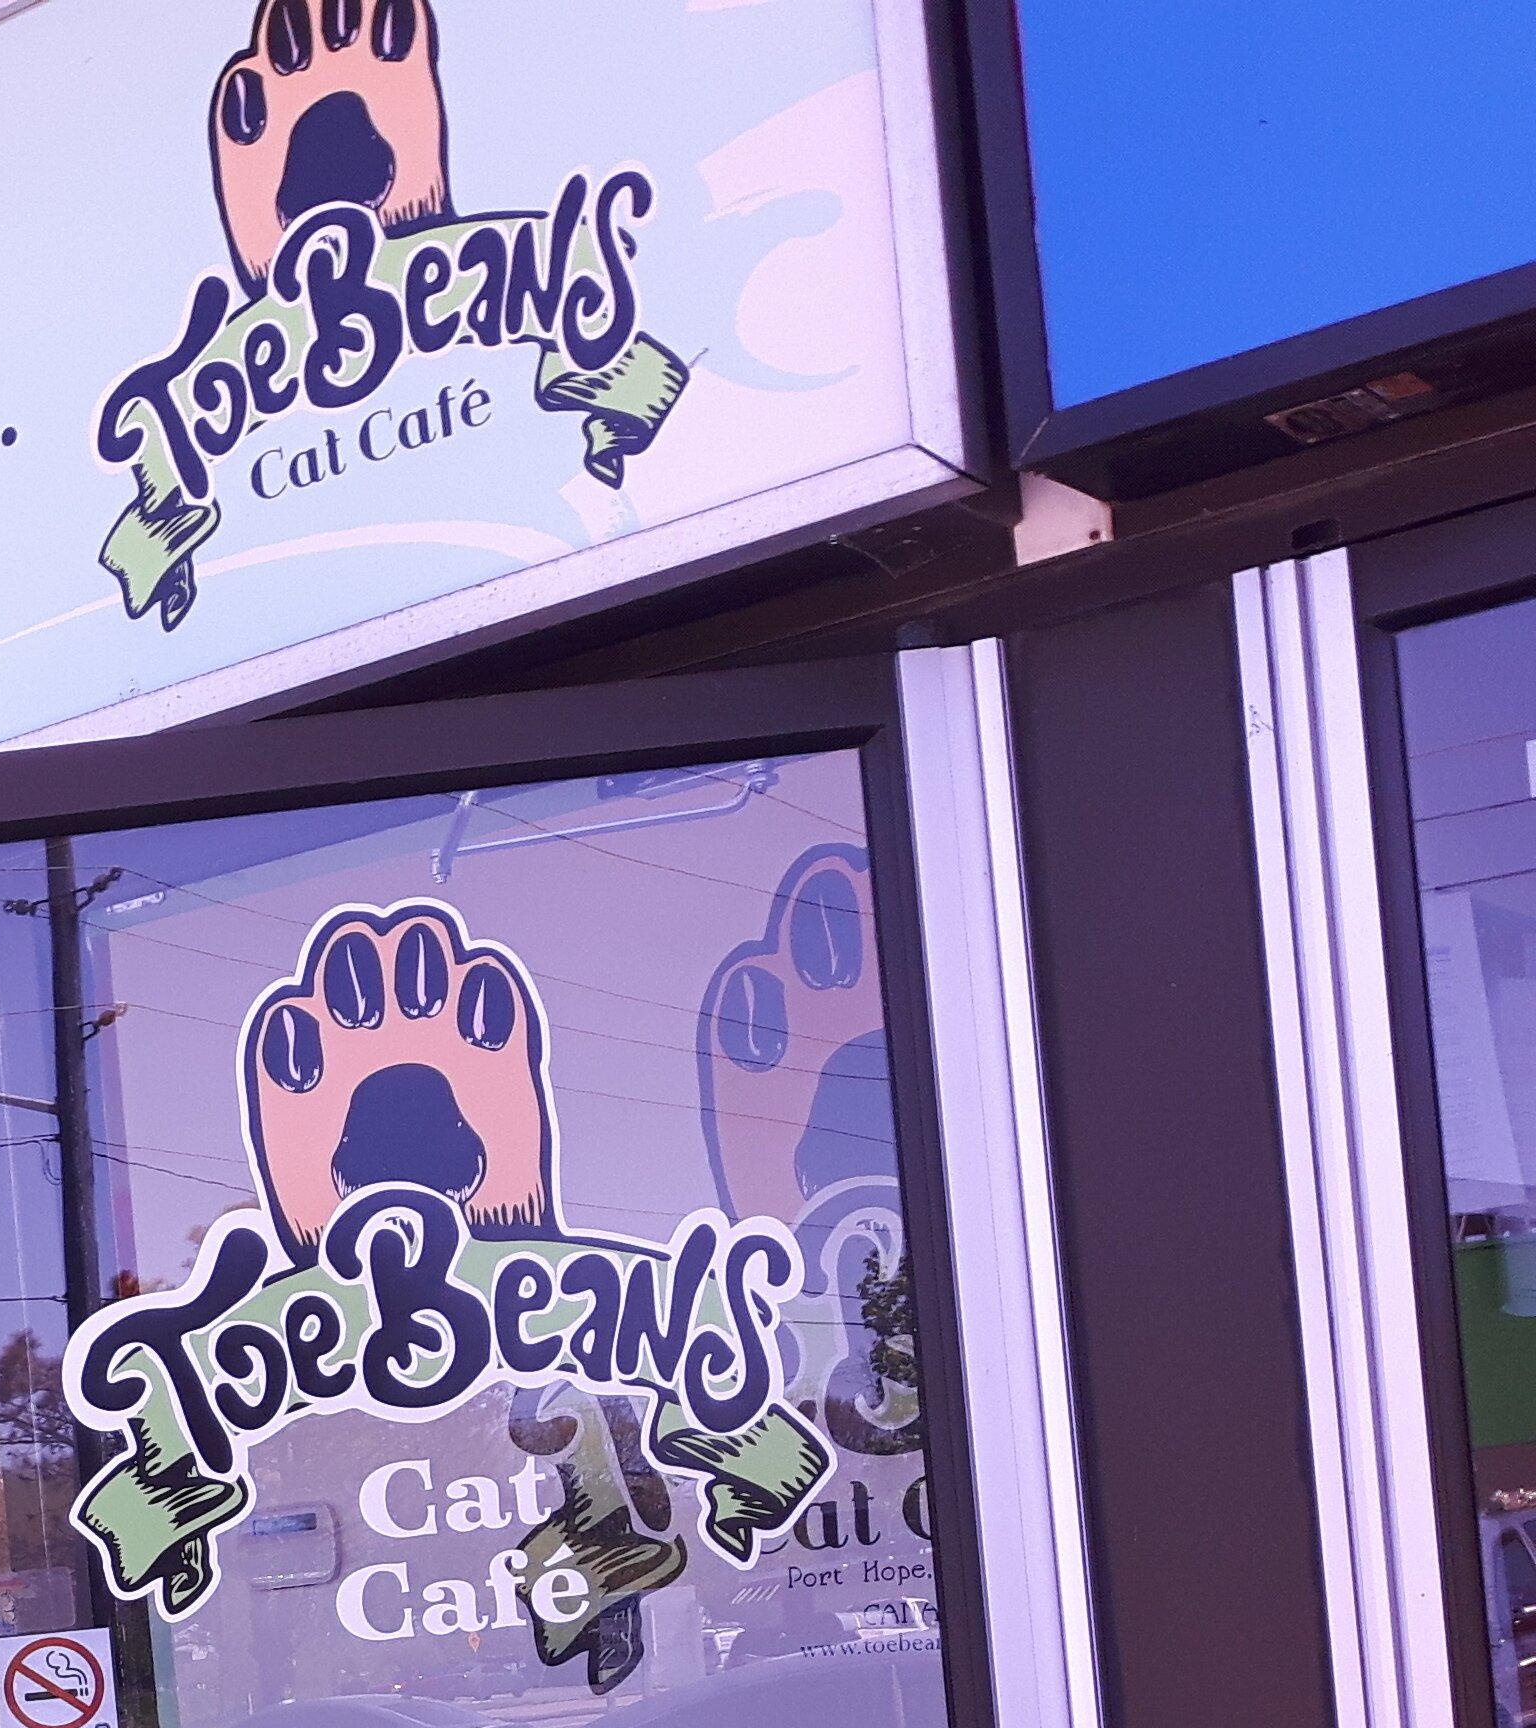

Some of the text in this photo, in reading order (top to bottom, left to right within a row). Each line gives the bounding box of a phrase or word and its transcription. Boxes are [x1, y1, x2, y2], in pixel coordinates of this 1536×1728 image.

[249, 378, 493, 501] Cat Café
[358, 1455, 553, 1539] Cat
[335, 1542, 591, 1642] Café
[787, 1565, 844, 1589] Port
